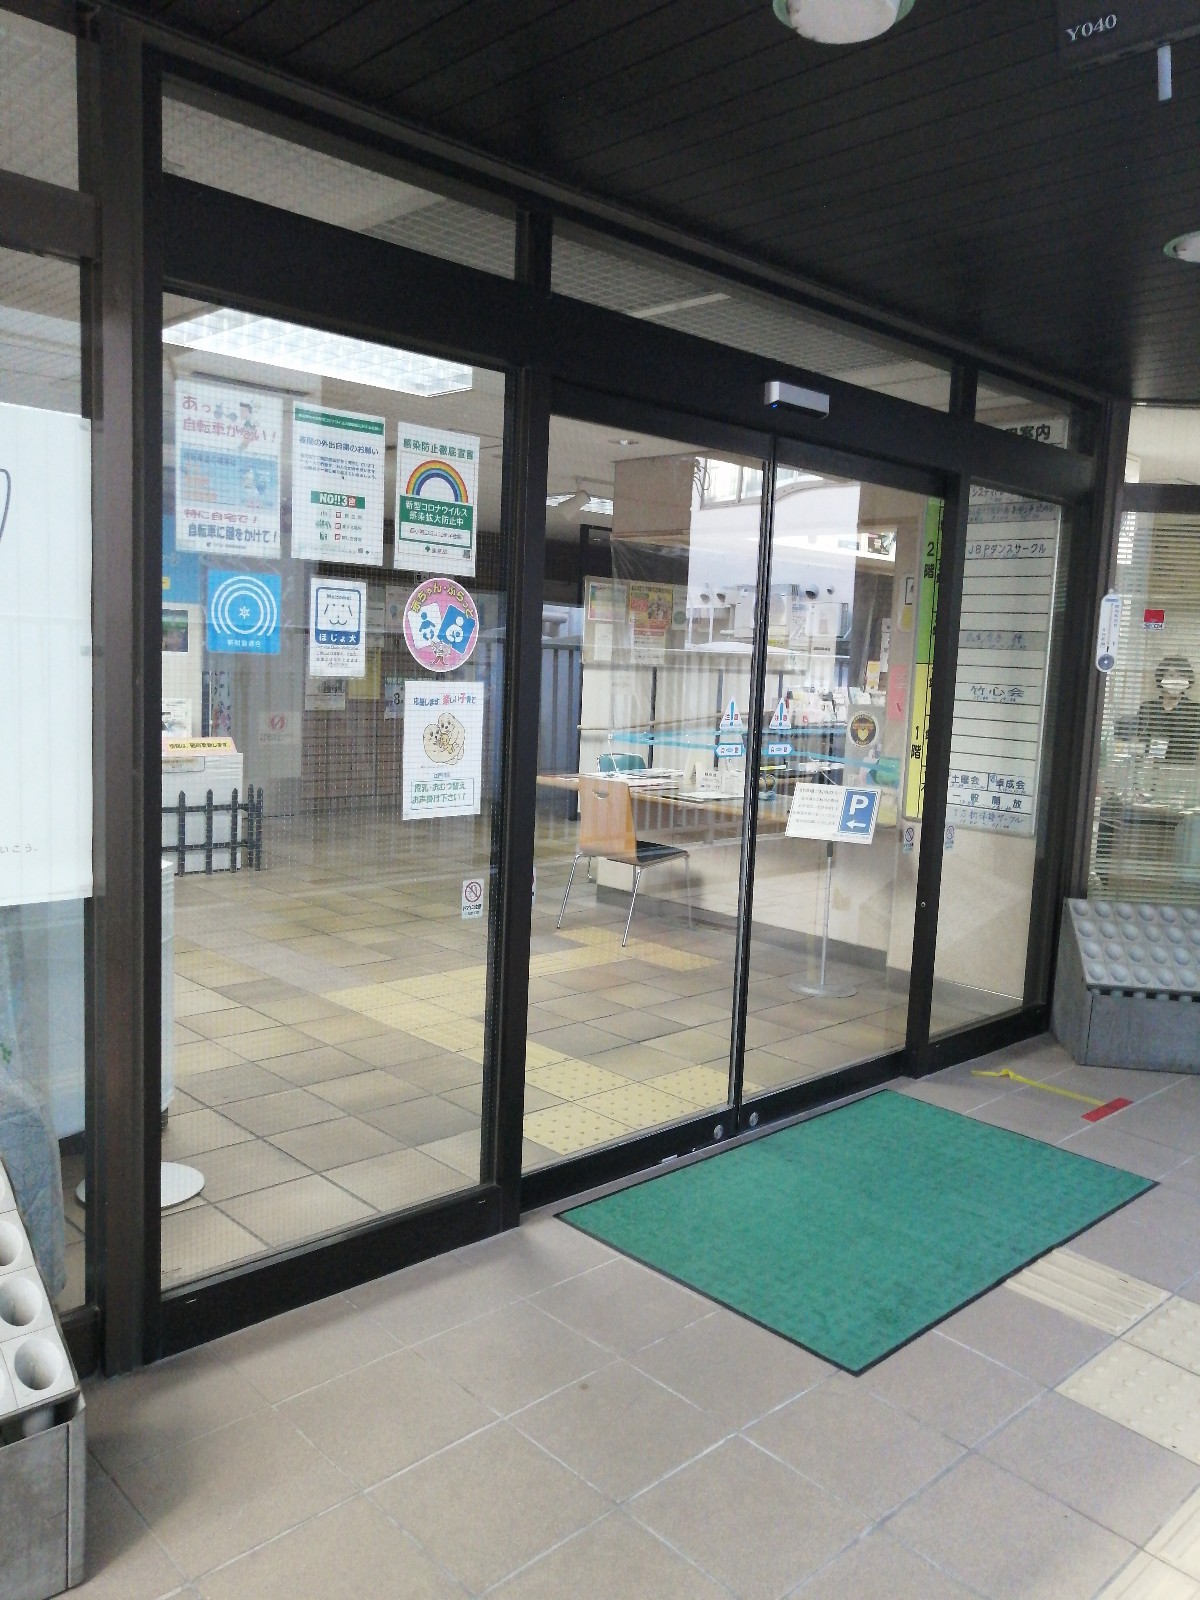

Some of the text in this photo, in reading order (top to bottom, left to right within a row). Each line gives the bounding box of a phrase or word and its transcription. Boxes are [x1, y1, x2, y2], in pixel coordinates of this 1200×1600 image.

[1065, 14, 1117, 41] Y040
[183, 396, 211, 412] あっ
[299, 435, 379, 455] 夜間の外出自粛のお願い
[403, 438, 474, 460] 感染防止徹底宣言
[405, 500, 468, 516] 新型コロナウイルス
[409, 511, 464, 526] 感染拡大防止中
[923, 541, 936, 579] 2階
[319, 633, 357, 643] ほじょ犬
[413, 692, 476, 707] 応援します 楽しい子育て
[970, 685, 1025, 697] 竹心会
[911, 725, 923, 760] 1階
[849, 794, 869, 815] P
